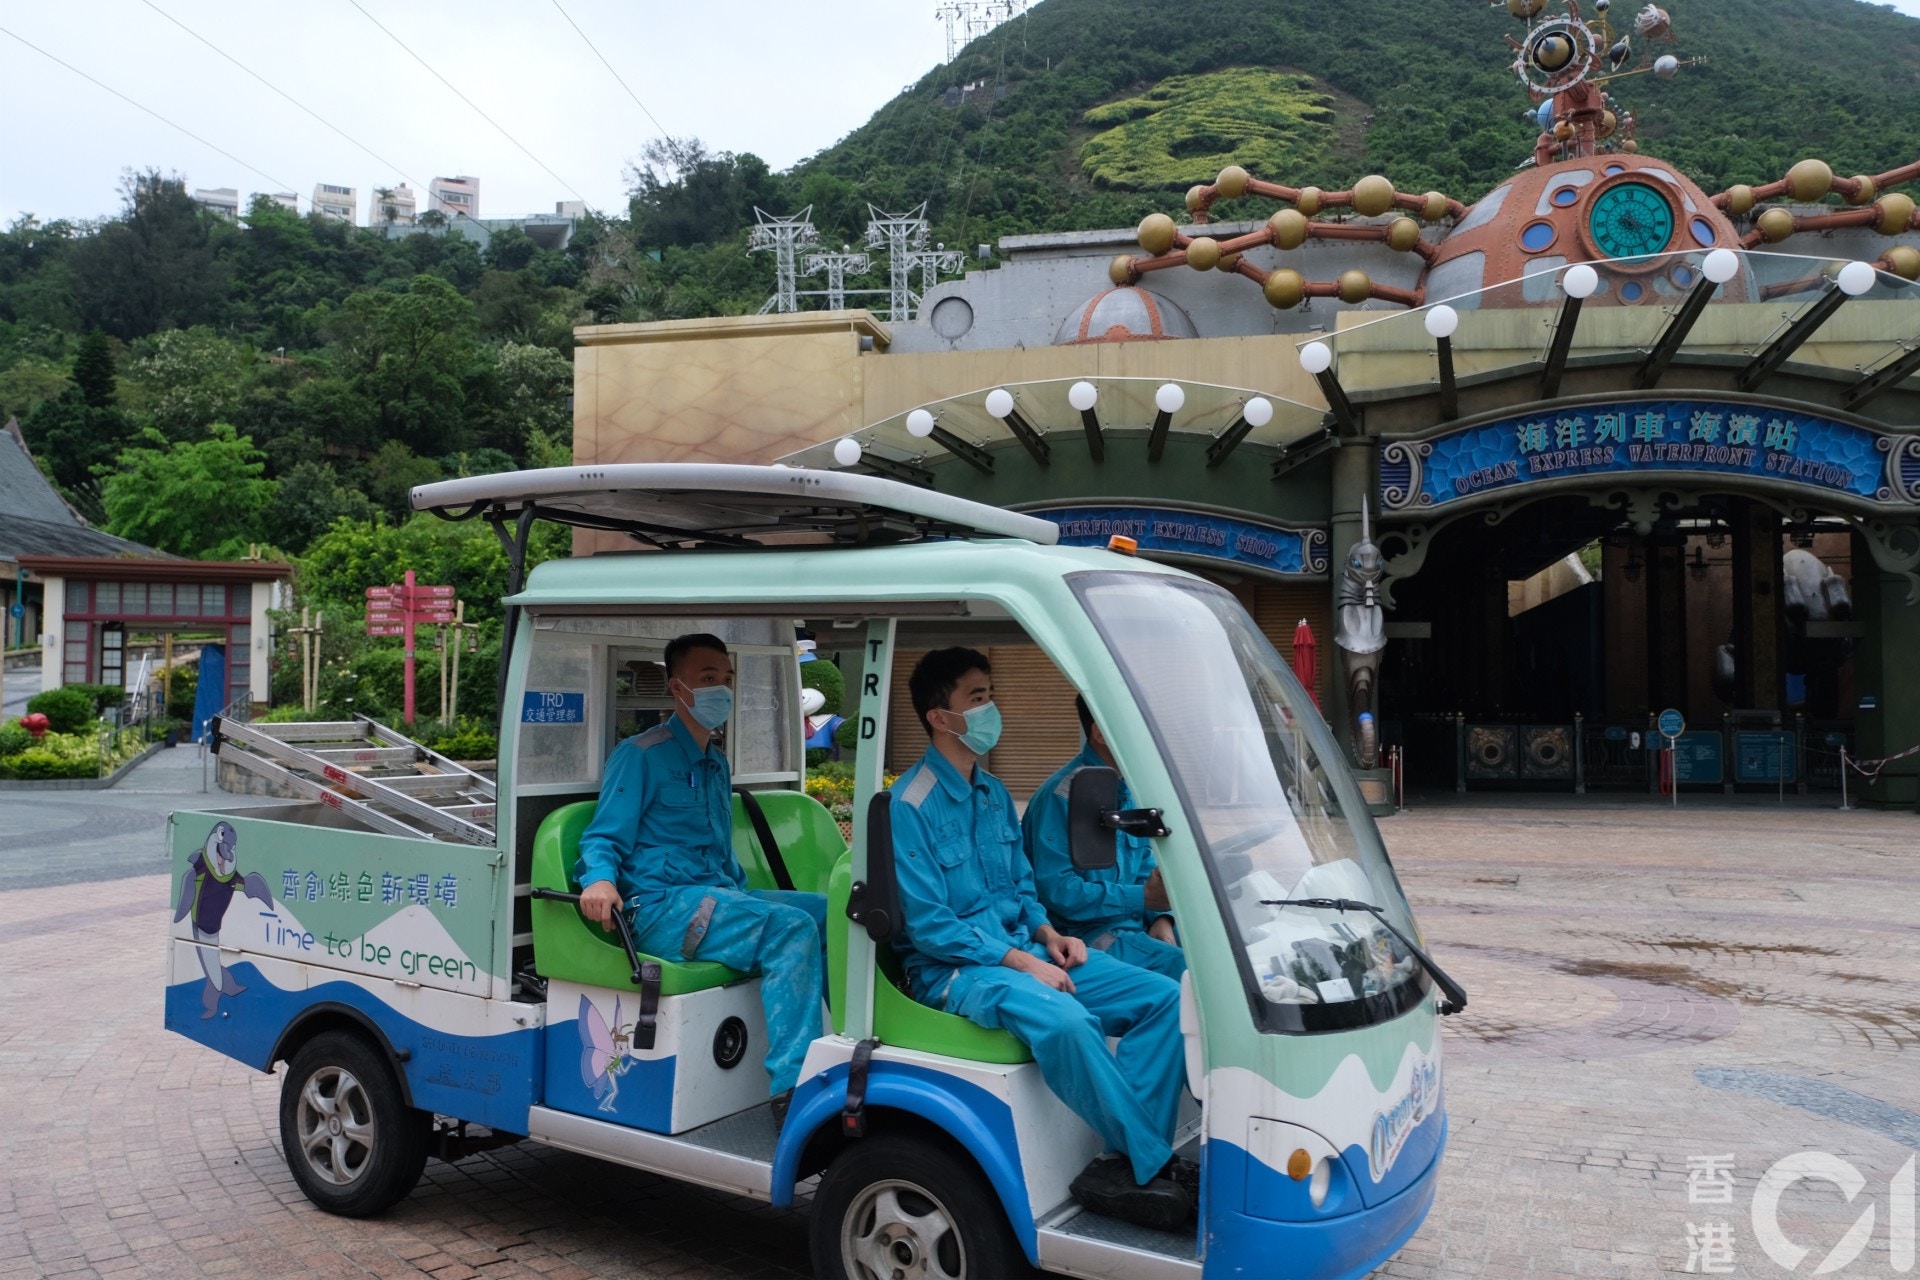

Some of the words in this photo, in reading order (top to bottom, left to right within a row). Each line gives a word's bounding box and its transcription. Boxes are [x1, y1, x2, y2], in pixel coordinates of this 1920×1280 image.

[1455, 459, 1518, 494] OCEAN
[1529, 446, 1615, 474] EXPRESS
[1629, 443, 1757, 467] WATERFRONT
[1765, 452, 1854, 489] STATION
[1058, 519, 1146, 537] TERFRONT
[1152, 520, 1226, 546] EXPRESS
[1234, 535, 1278, 560] SHOP
[525, 708, 576, 722] 交通管理部
[539, 692, 564, 708] TRD
[282, 868, 459, 909] 齊創綠色新環境
[259, 911, 316, 951] Time
[324, 930, 353, 959] to
[361, 934, 391, 965] be
[400, 949, 477, 982] green
